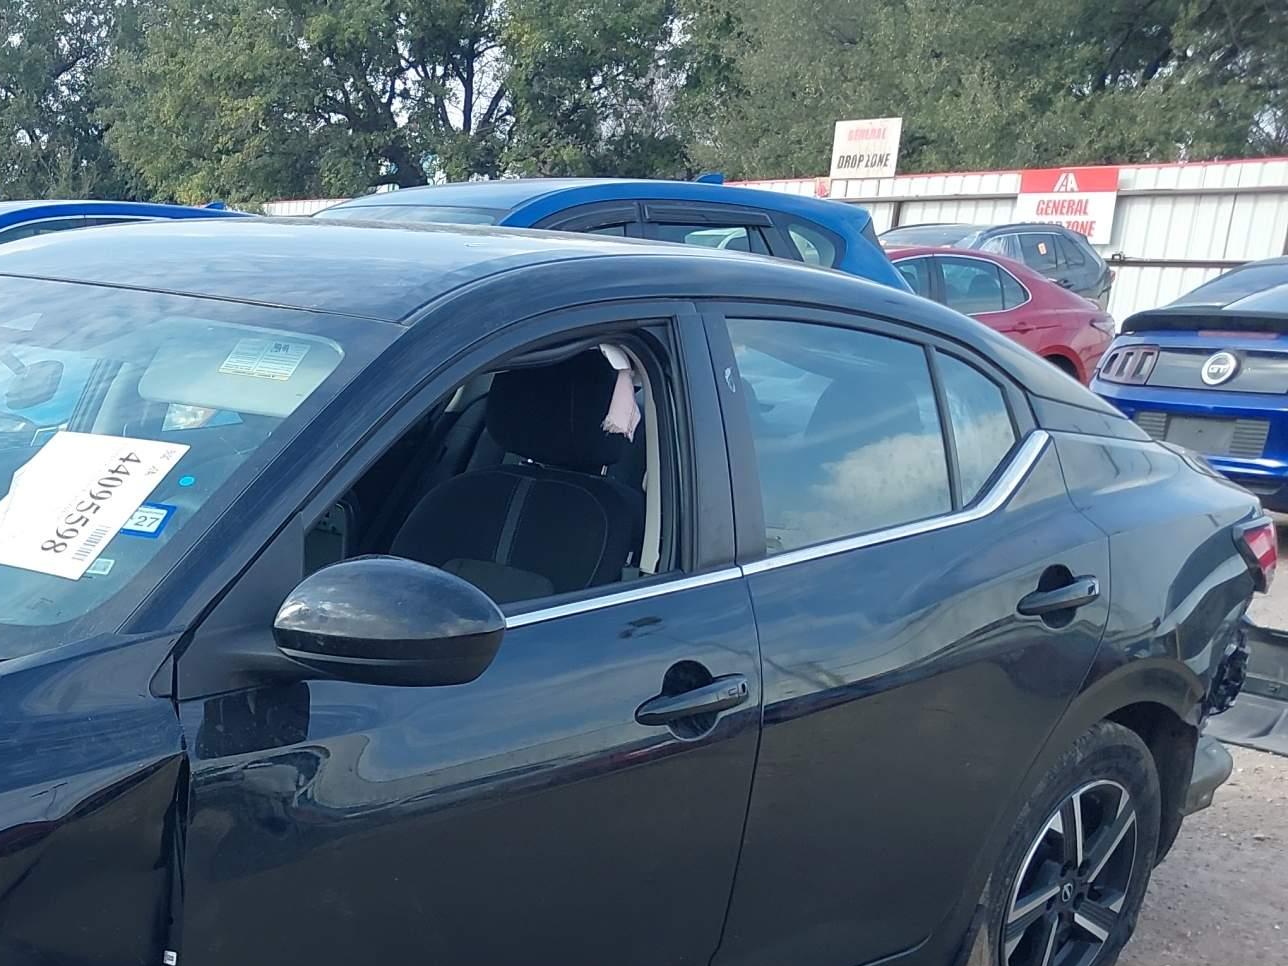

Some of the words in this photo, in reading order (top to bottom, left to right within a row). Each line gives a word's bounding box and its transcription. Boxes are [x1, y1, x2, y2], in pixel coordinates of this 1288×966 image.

[837, 153, 865, 169] DROP
[864, 152, 891, 168] ZONE
[1035, 198, 1089, 216] GENERAL
[40, 451, 141, 554] 44095598
[133, 515, 161, 528] 27
